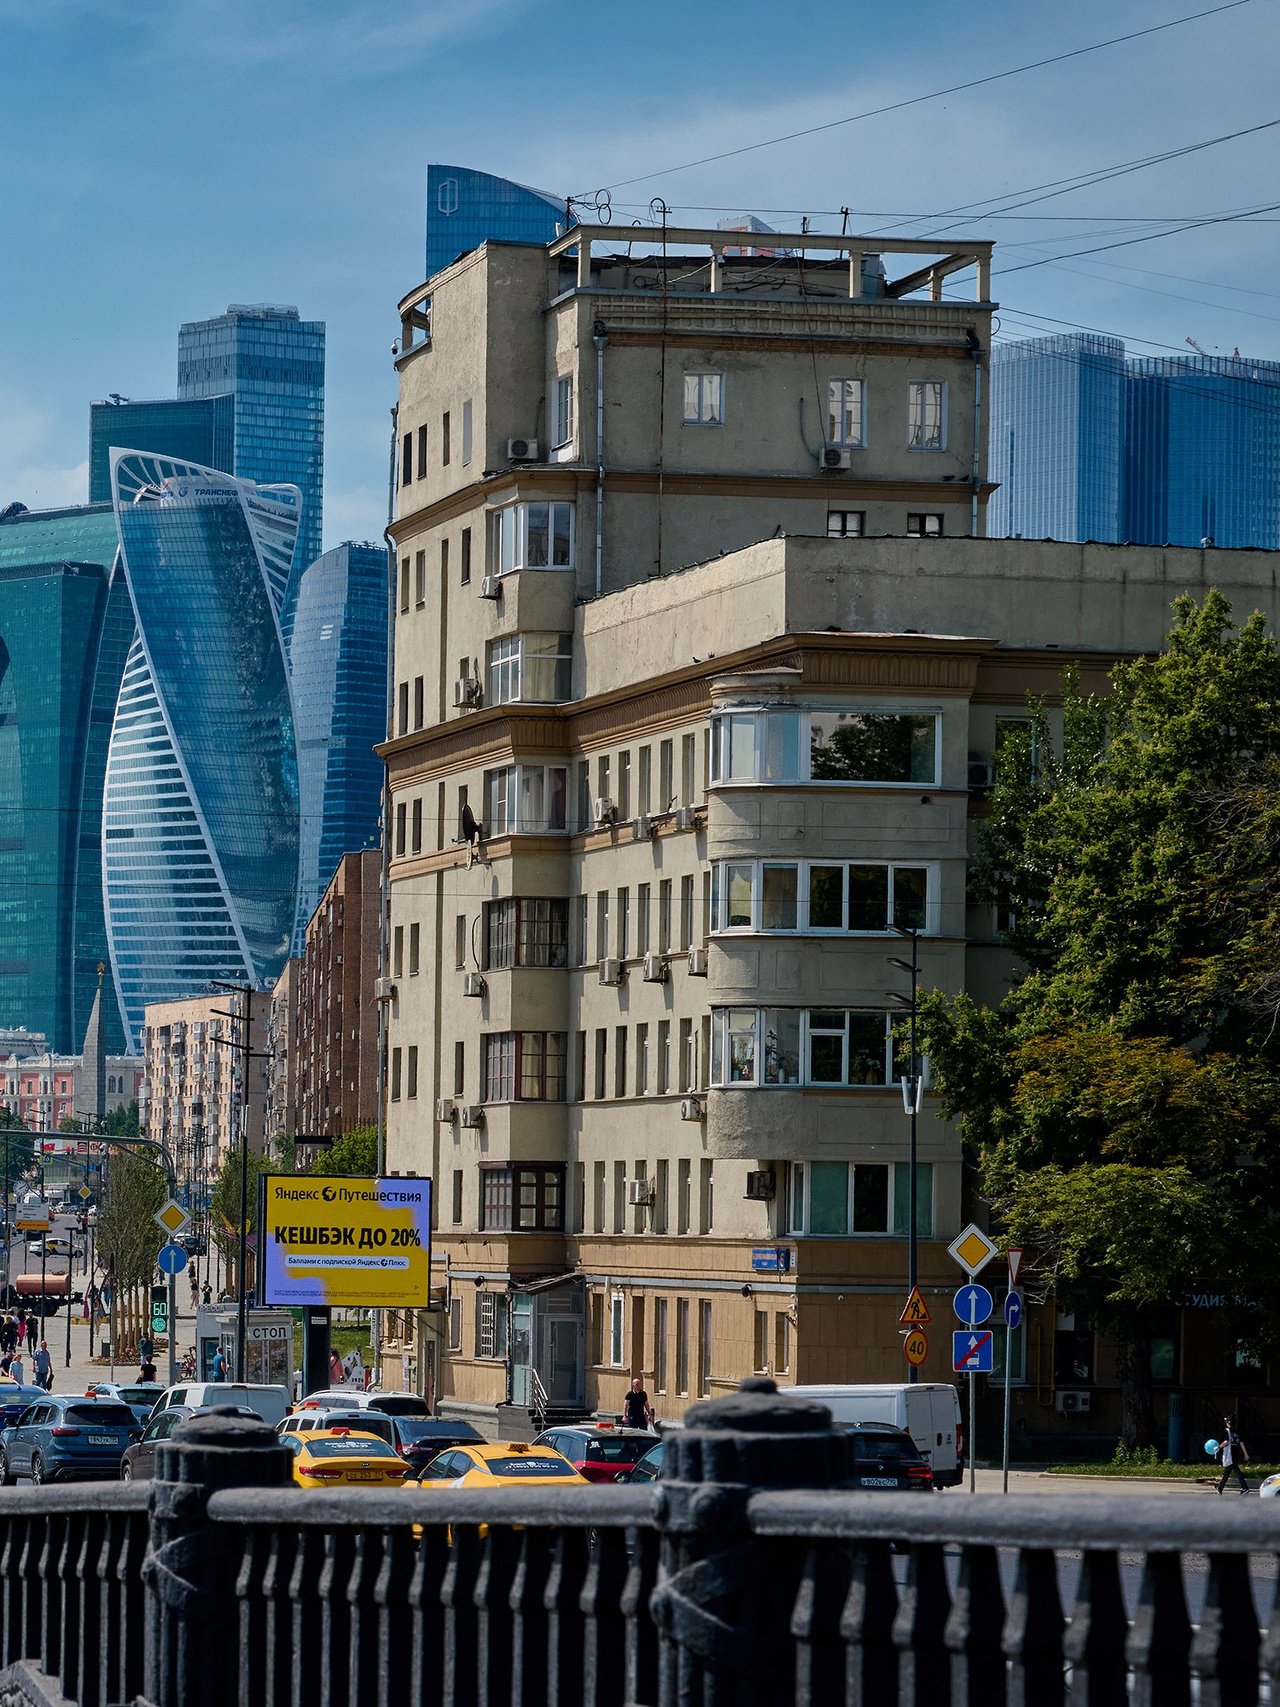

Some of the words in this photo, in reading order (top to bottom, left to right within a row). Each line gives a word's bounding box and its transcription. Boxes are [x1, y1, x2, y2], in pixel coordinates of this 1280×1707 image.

[275, 1187, 319, 1201] Яндекс
[339, 1188, 422, 1203] Путешествия
[274, 1226, 355, 1246] КЕШБЭК
[358, 1228, 387, 1250] ДО
[390, 1228, 421, 1247] 20%
[288, 1257, 316, 1265] Баллами
[321, 1258, 357, 1266] подпиской
[357, 1259, 380, 1267] Яндекс
[153, 1302, 167, 1316] 60
[253, 1327, 287, 1339] СТОП
[909, 1341, 924, 1355] 40
